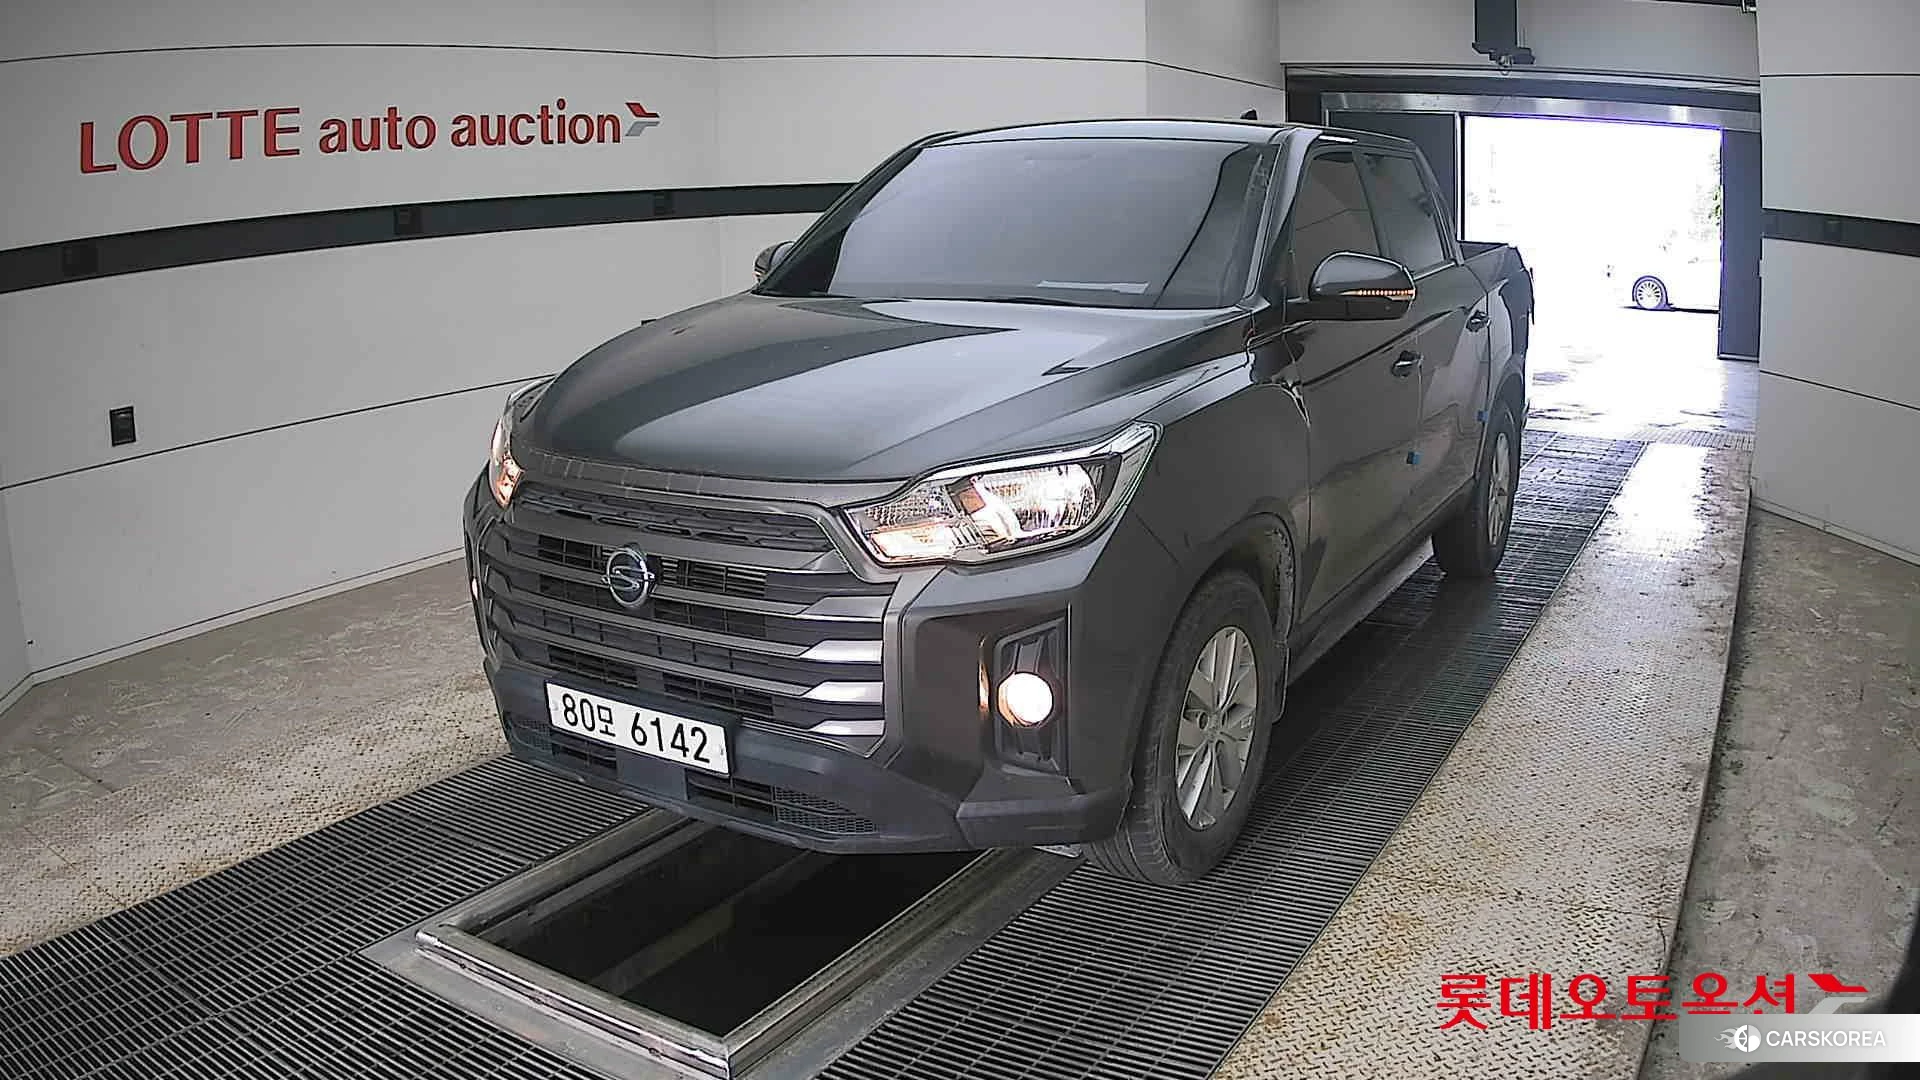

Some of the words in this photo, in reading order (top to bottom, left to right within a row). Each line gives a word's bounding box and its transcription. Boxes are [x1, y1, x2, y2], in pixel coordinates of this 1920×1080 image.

[80, 107, 300, 174] LOTTE
[319, 106, 436, 154] auto
[450, 98, 622, 148] auction
[562, 693, 616, 738] 80모
[631, 712, 710, 764] 6142
